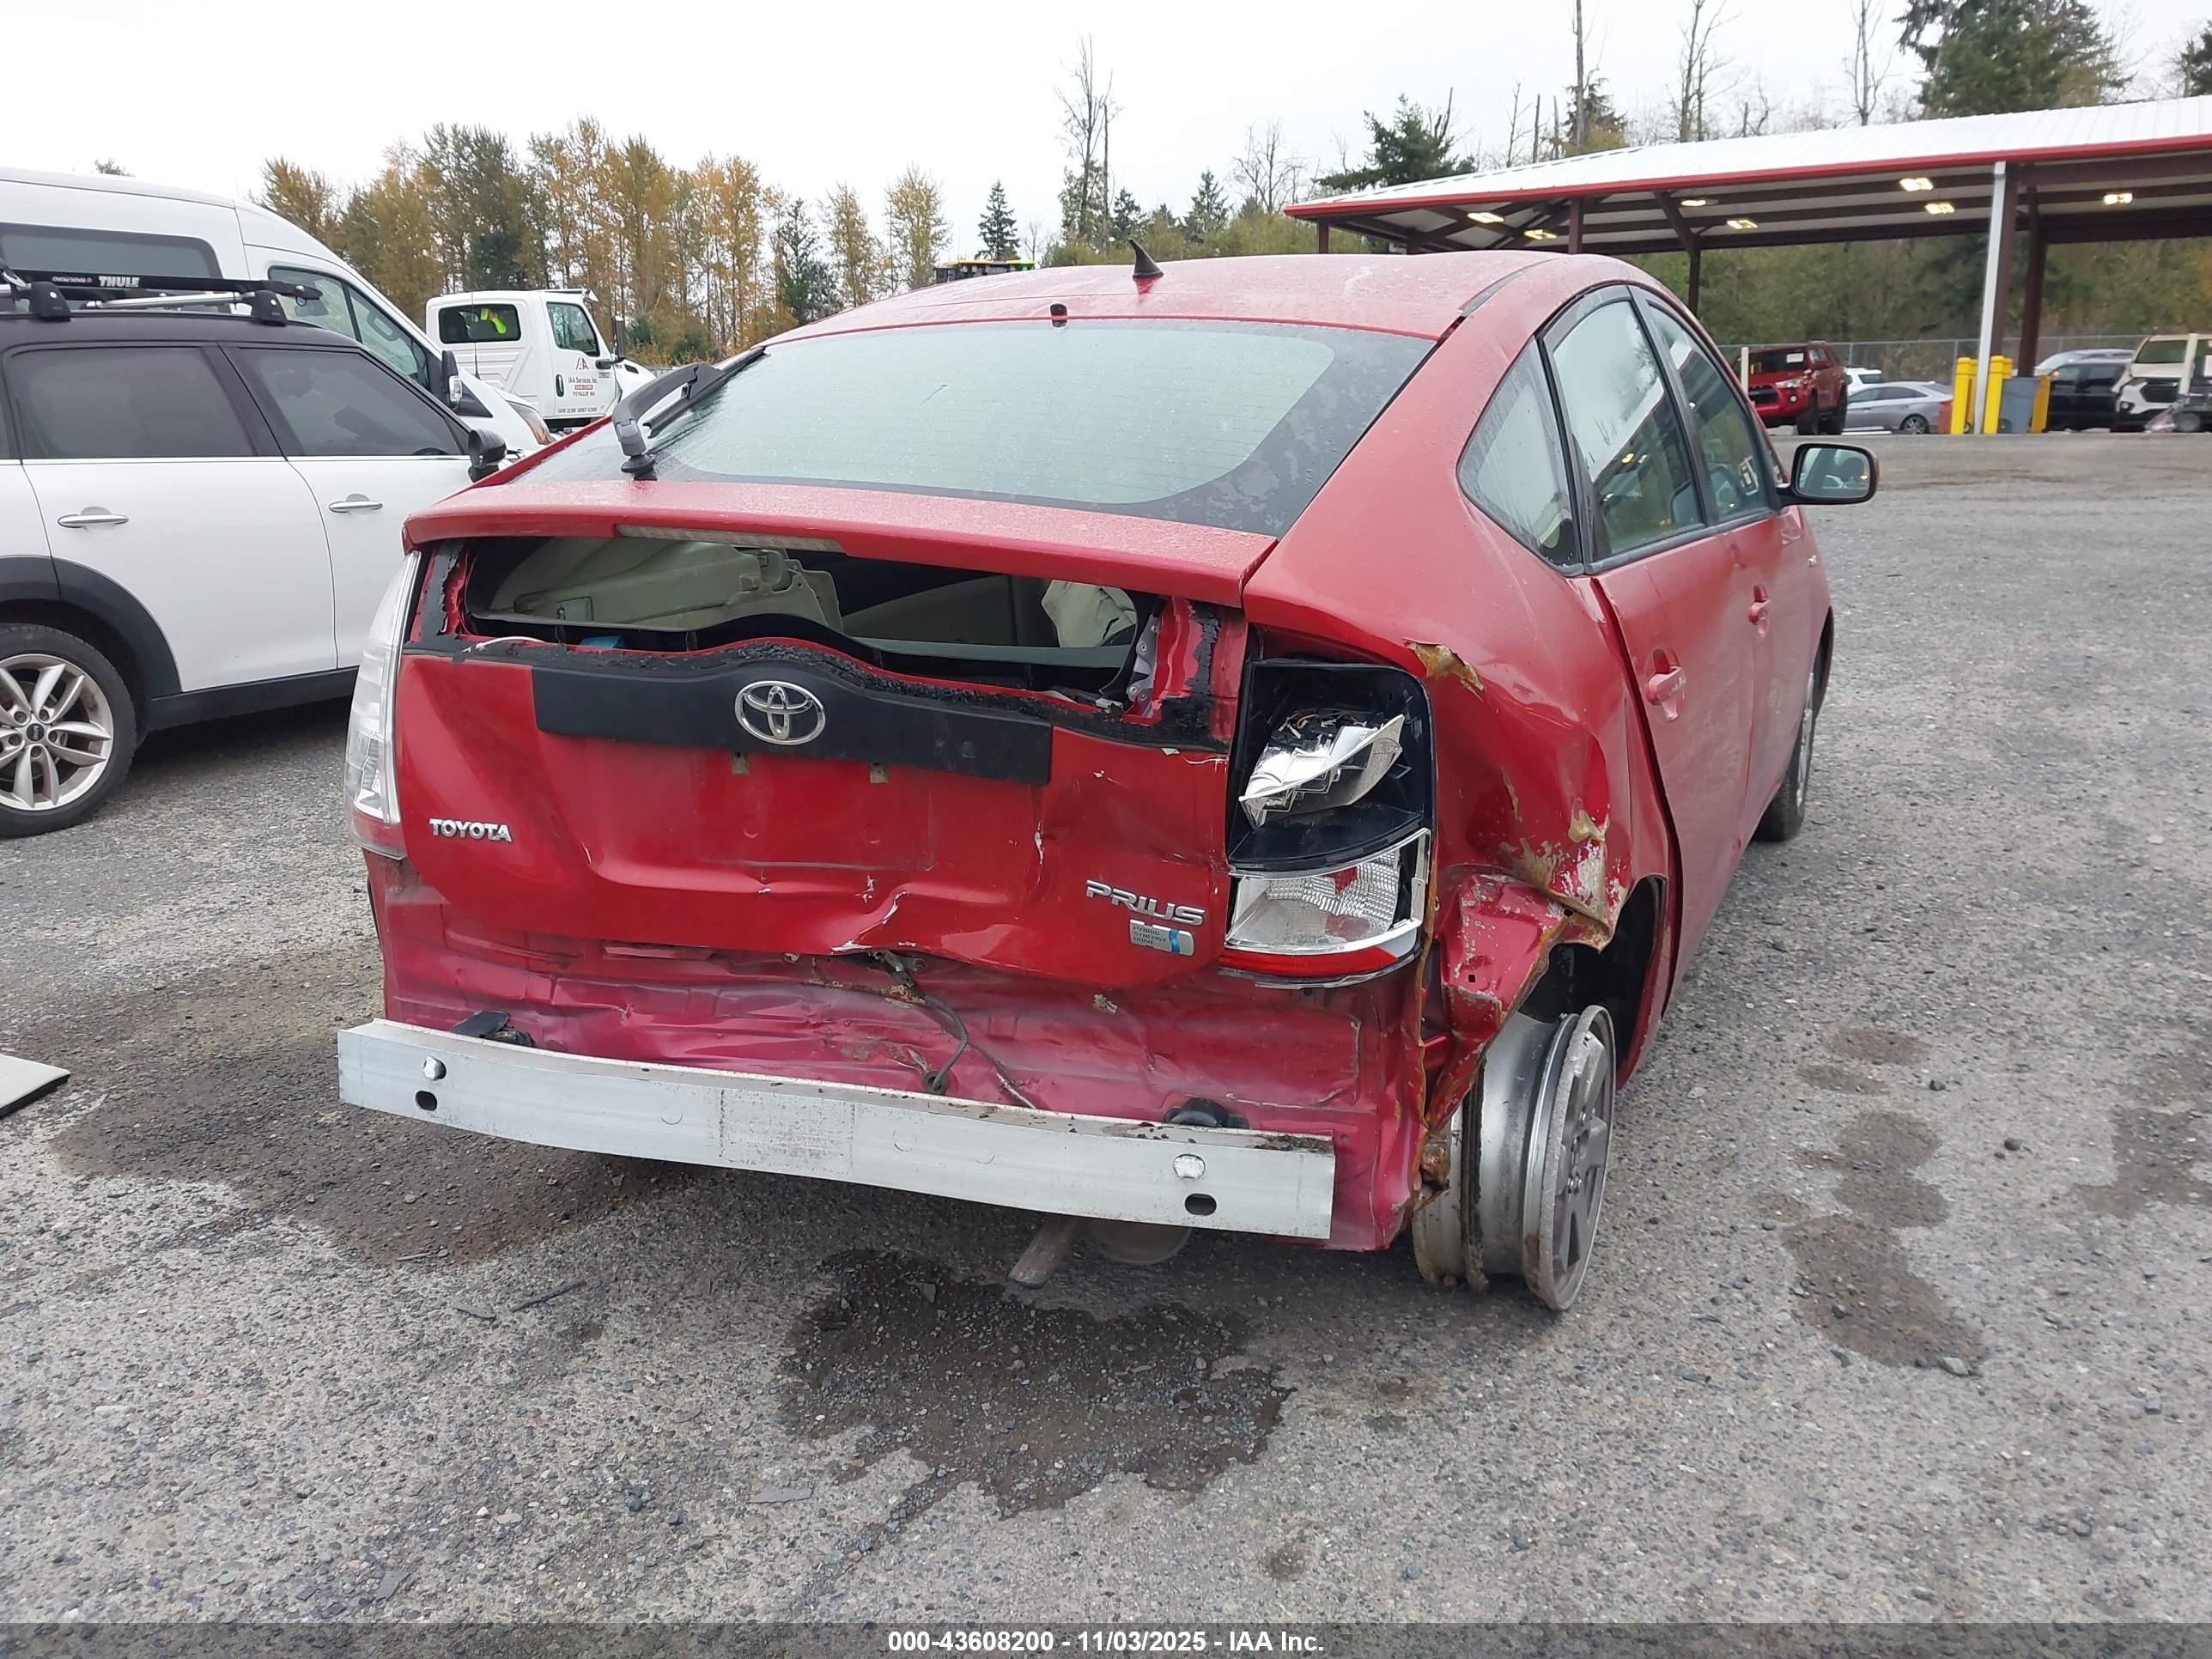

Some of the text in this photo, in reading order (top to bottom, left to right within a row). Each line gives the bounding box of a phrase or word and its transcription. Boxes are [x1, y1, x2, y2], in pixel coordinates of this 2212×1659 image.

[99, 276, 140, 288] THULE
[428, 817, 513, 842] TOYOTA
[1085, 879, 1206, 926] PRIUS
